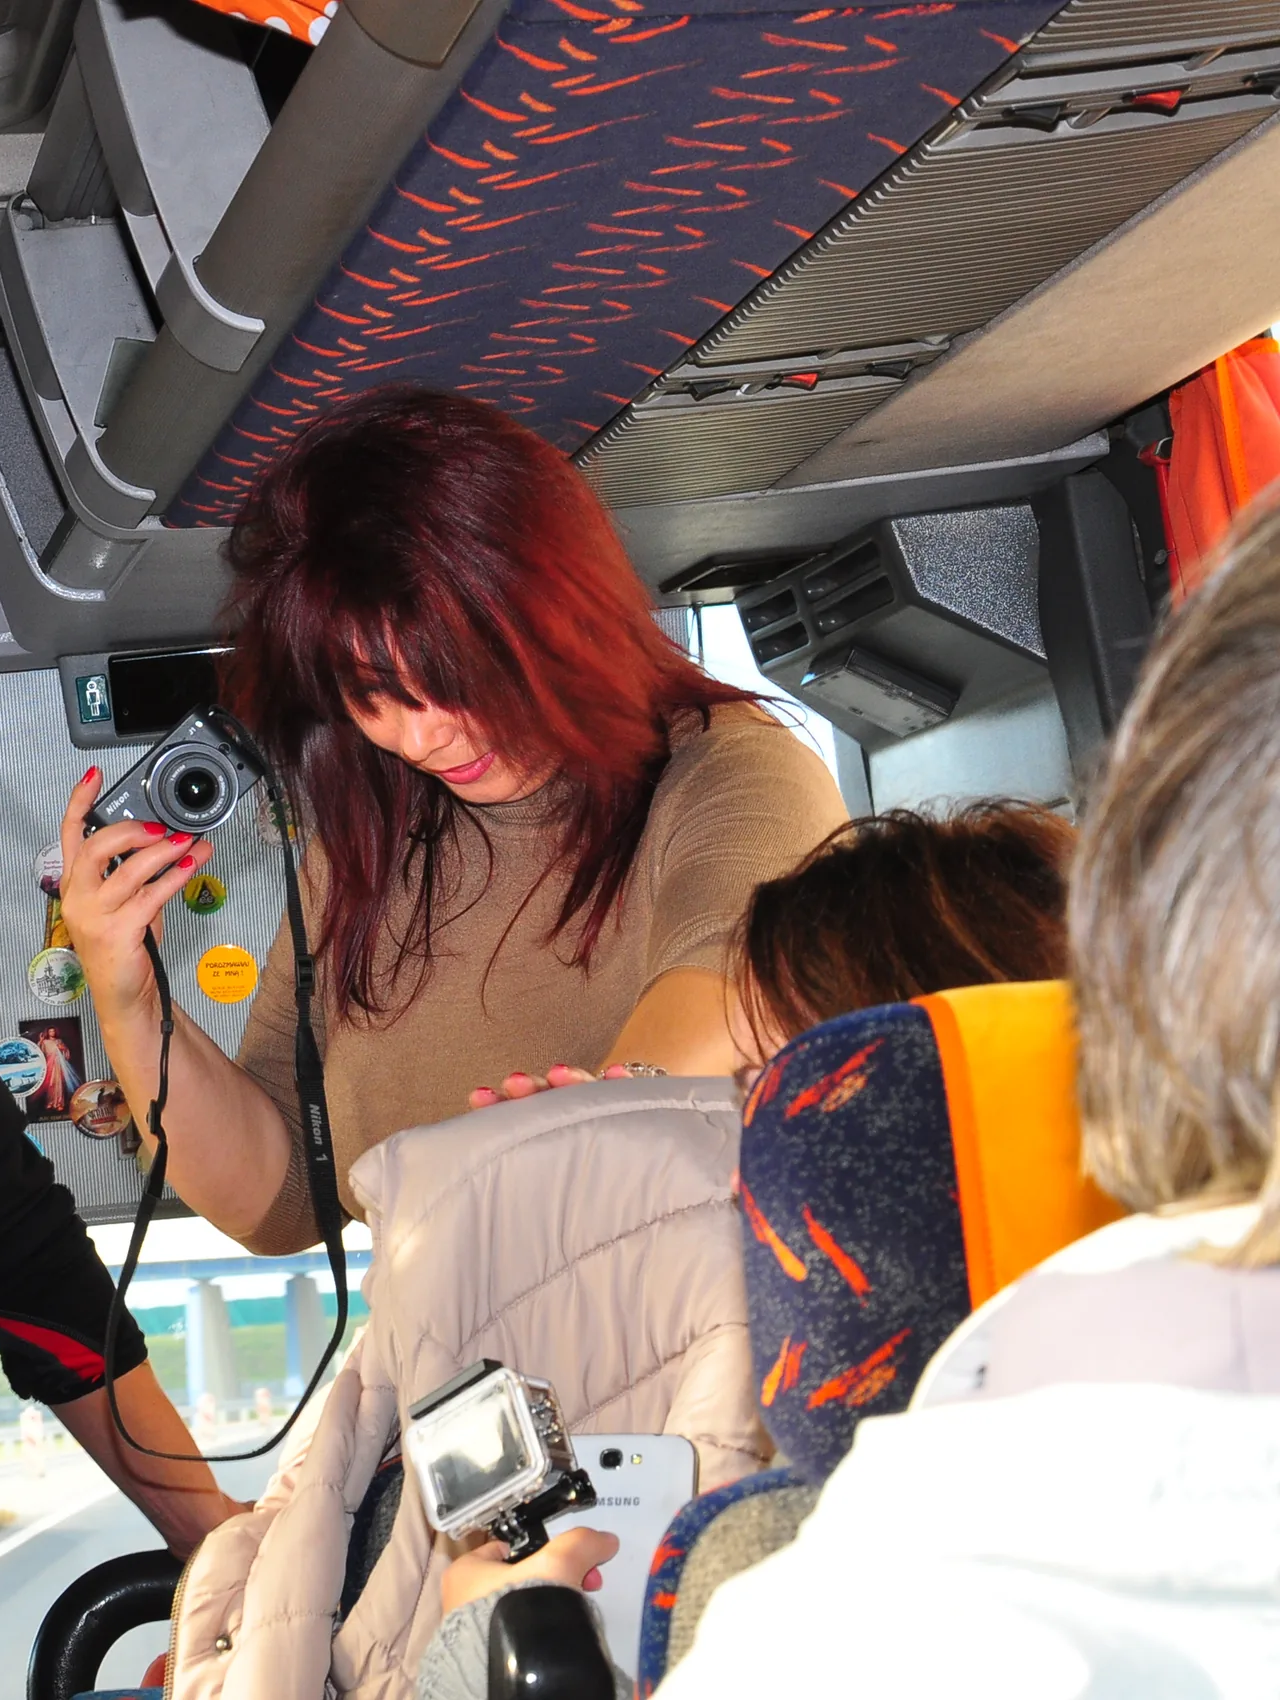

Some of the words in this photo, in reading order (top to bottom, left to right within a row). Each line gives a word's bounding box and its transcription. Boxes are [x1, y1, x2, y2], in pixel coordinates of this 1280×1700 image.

[105, 791, 130, 816] Nikon
[308, 1103, 323, 1145] Nikon
[315, 1153, 329, 1161] 1
